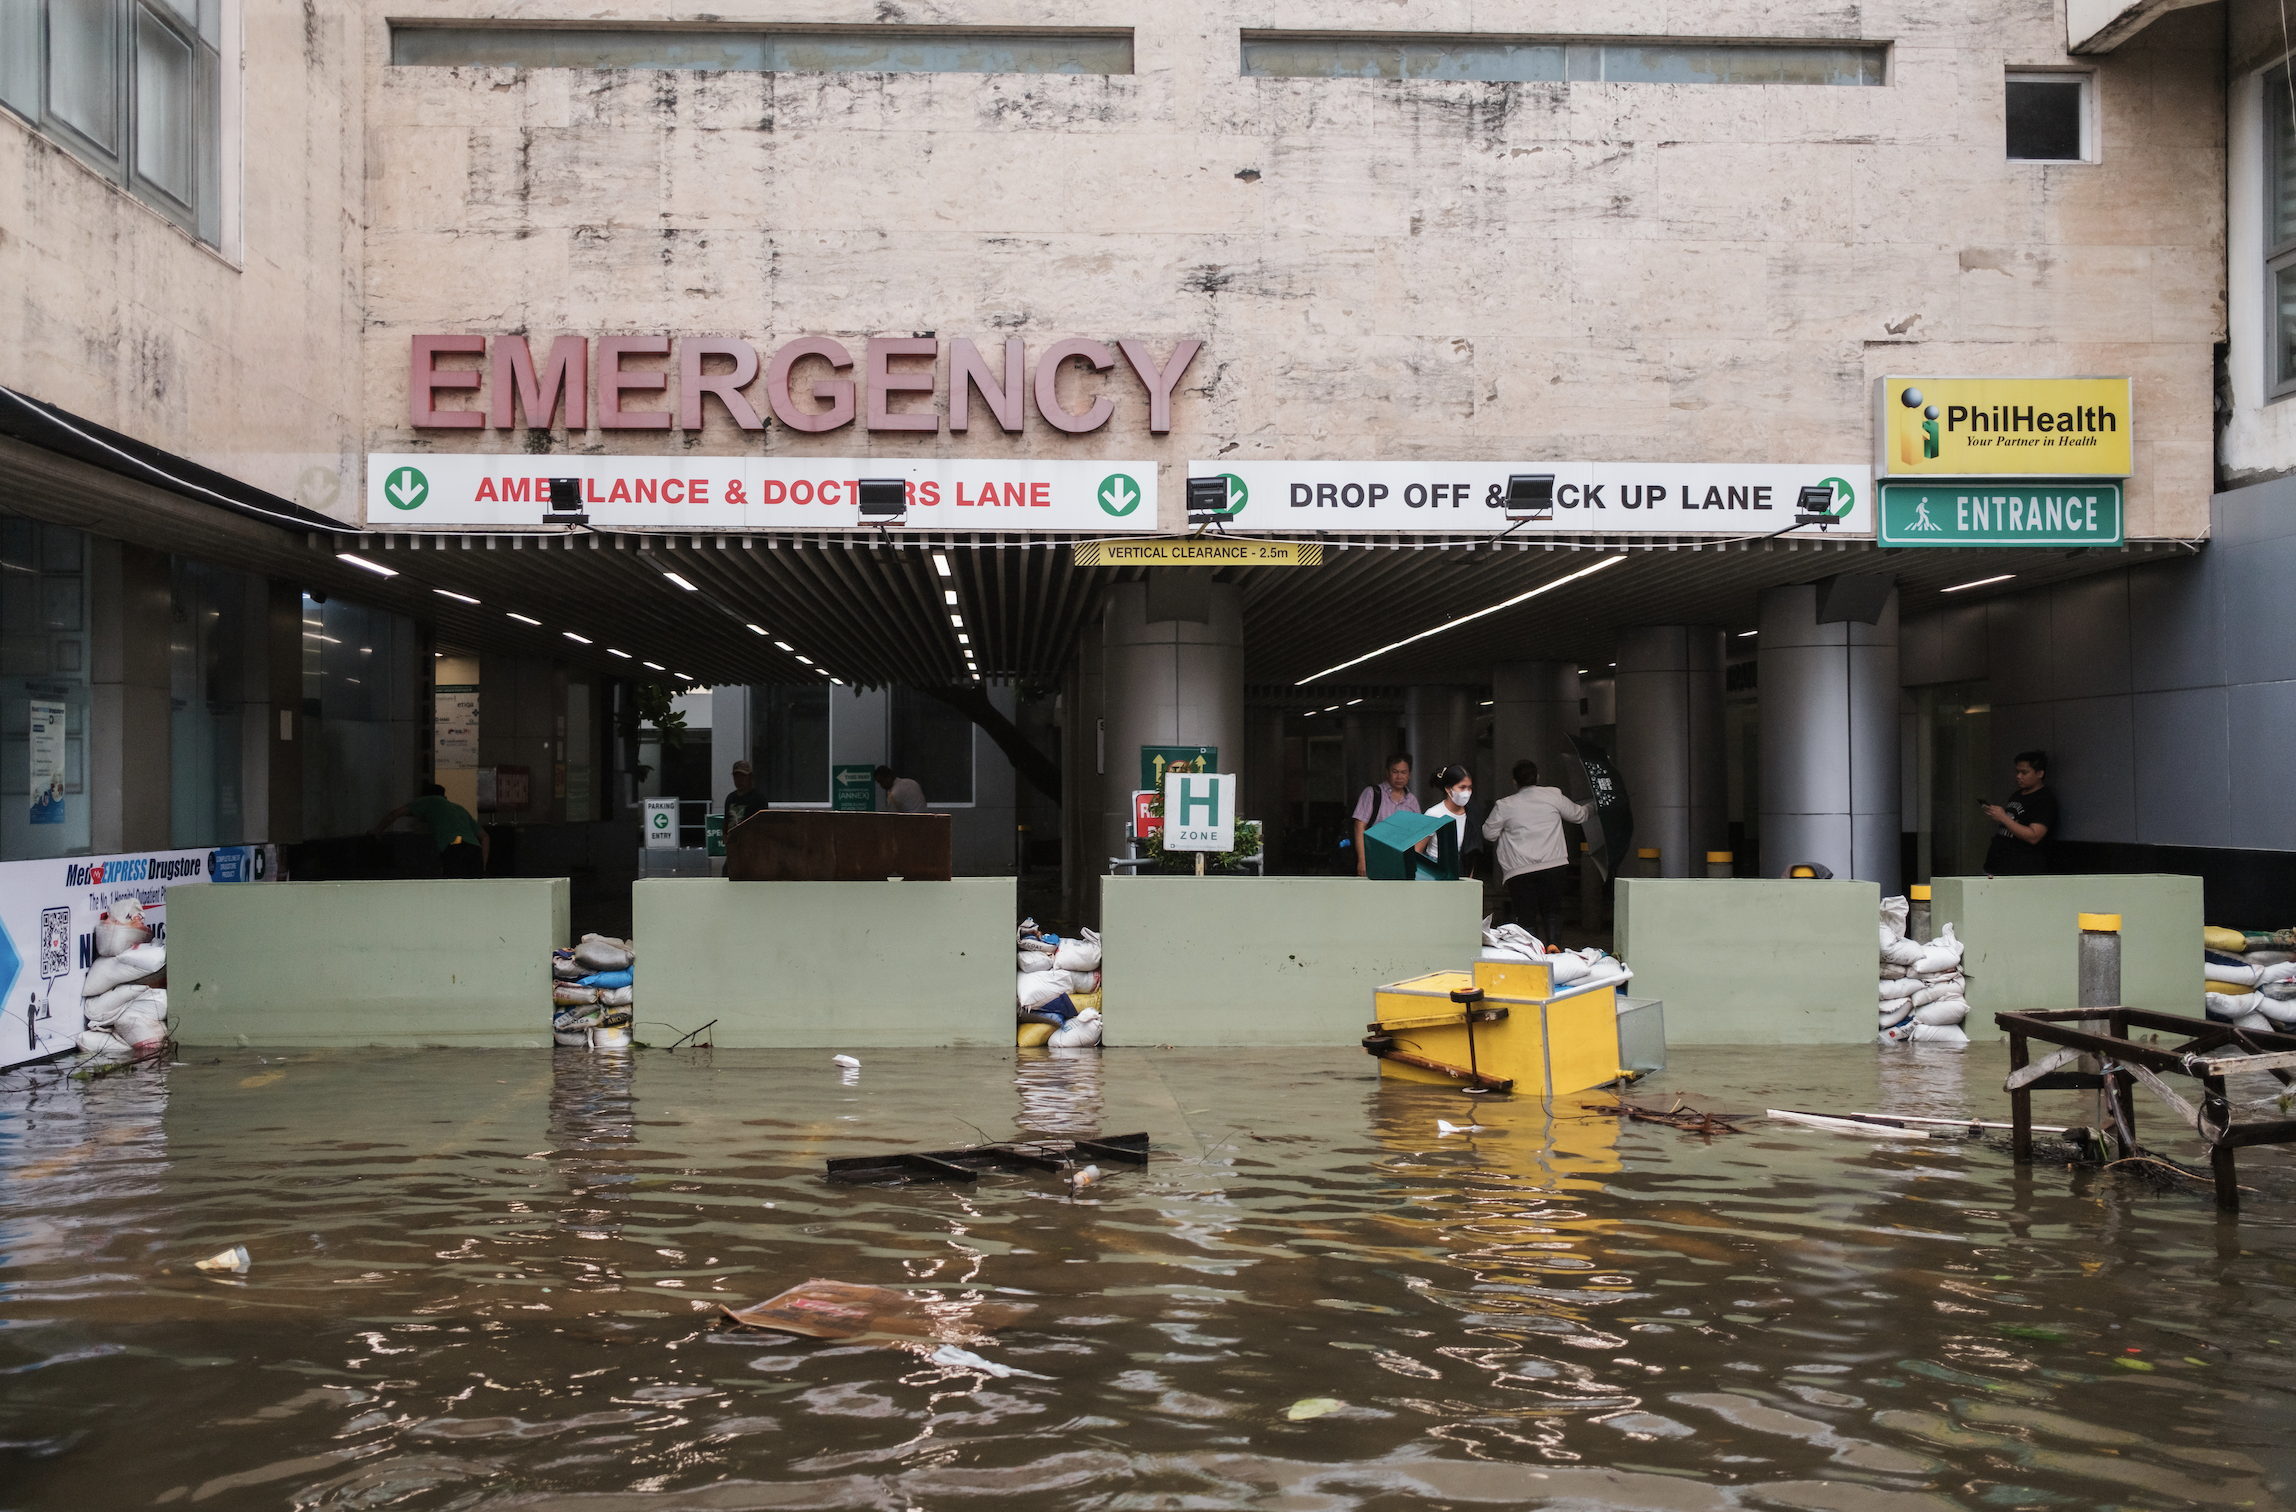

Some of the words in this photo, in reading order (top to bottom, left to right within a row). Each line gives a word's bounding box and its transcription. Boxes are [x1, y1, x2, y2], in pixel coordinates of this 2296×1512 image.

[411, 334, 1203, 436] EMERGENCY
[1947, 405, 2117, 433] PhilHealth
[1966, 435, 1993, 448] Your
[1996, 435, 2040, 448] Partner
[2043, 435, 2055, 448] in
[2058, 435, 2098, 448] Health
[475, 477, 709, 504] AMBLANCE
[725, 479, 748, 504] &
[764, 479, 941, 506] DOCTRS
[956, 482, 1050, 507] LANE
[1290, 483, 1389, 509] DROP
[1403, 483, 1471, 508] OFF
[1486, 483, 1506, 508] &
[1621, 485, 1667, 510] UP
[1682, 485, 1774, 510] LANE
[1957, 496, 2098, 532] ENTRANCE
[1108, 547, 1168, 558] VERTICAL
[1172, 547, 1247, 558] CLEARANCE
[1259, 547, 1289, 558] 2.5m
[648, 802, 675, 810] PARKING
[838, 792, 870, 800] (ANNEX)
[1179, 777, 1219, 827] H
[652, 832, 672, 840] ENTRY
[1180, 831, 1217, 841] ZONE
[148, 857, 201, 881] Drugstore
[89, 892, 99, 911] The
